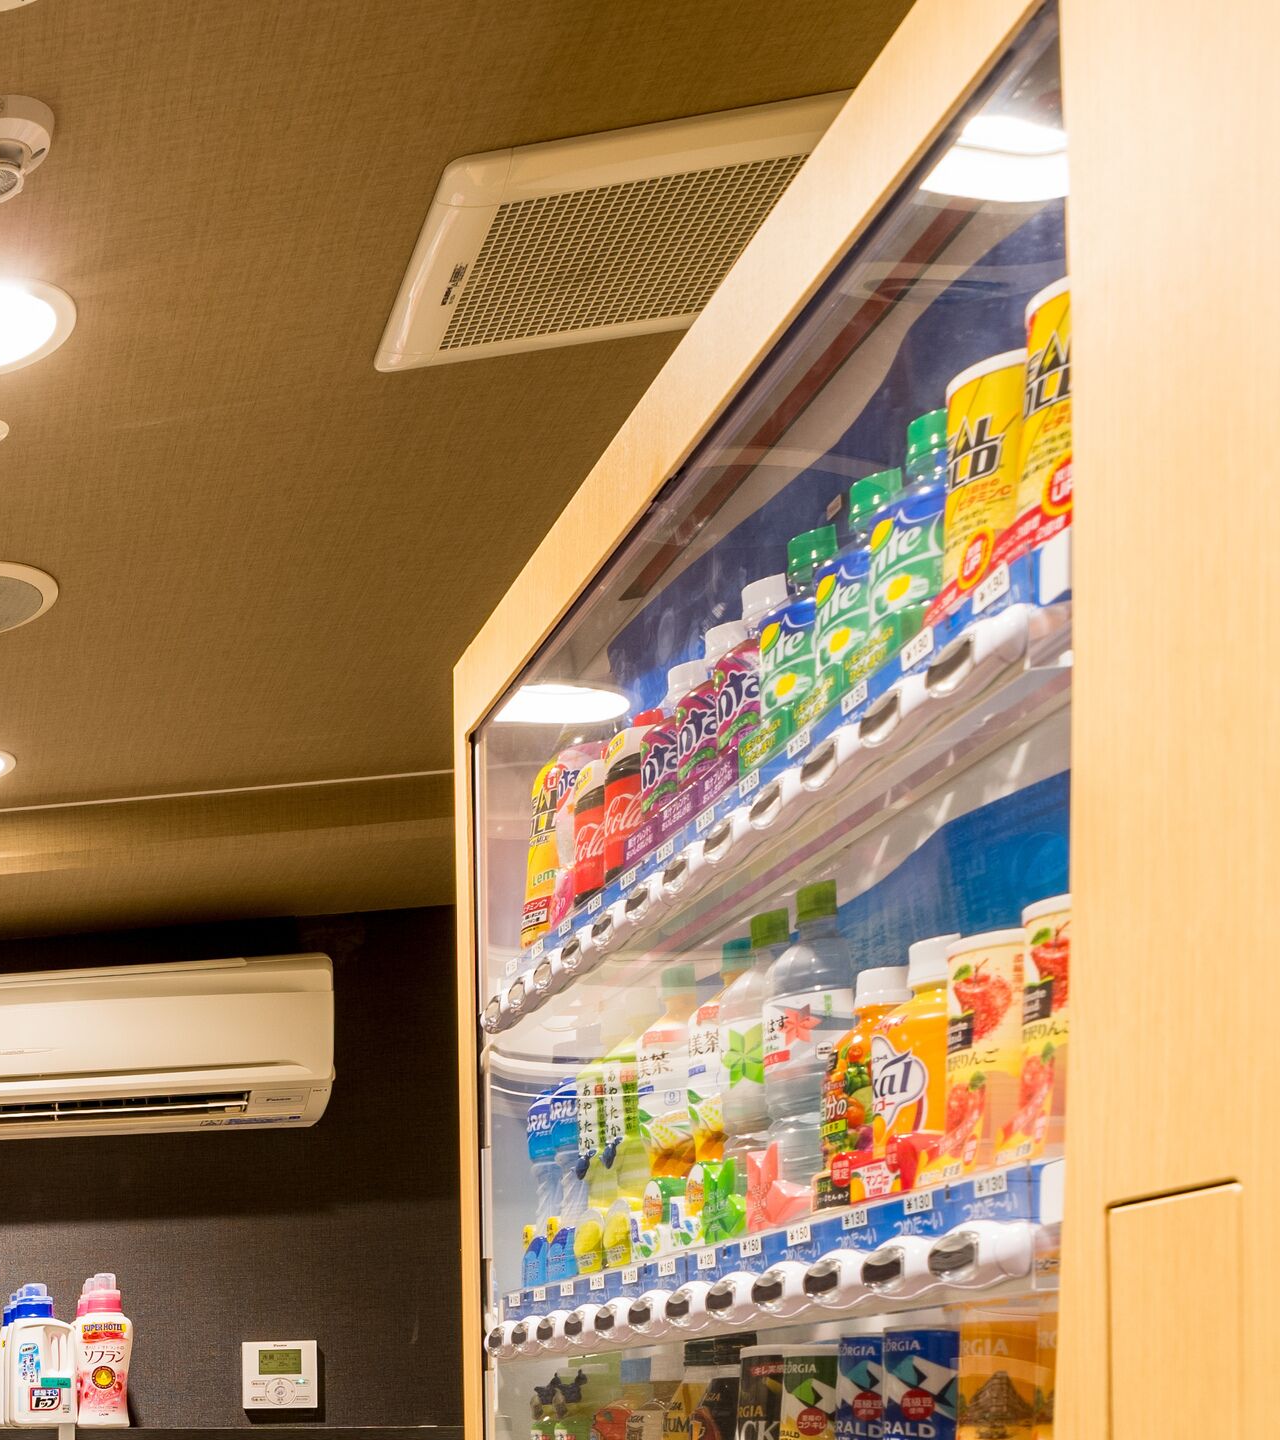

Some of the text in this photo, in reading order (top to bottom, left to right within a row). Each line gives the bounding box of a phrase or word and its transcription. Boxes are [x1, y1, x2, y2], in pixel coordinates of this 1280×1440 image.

[606, 1069, 621, 1137] あやたか
[976, 1174, 1007, 1193] ¥130
[905, 1193, 932, 1212] ¥130
[843, 1211, 867, 1227] ¥130
[789, 1227, 809, 1243] ¥150
[742, 1239, 761, 1252] ¥150
[699, 1253, 714, 1268] ¥120
[83, 1323, 123, 1333] SUPER HOTEL
[84, 1350, 126, 1365] ソフラン
[34, 1397, 59, 1408] トップ
